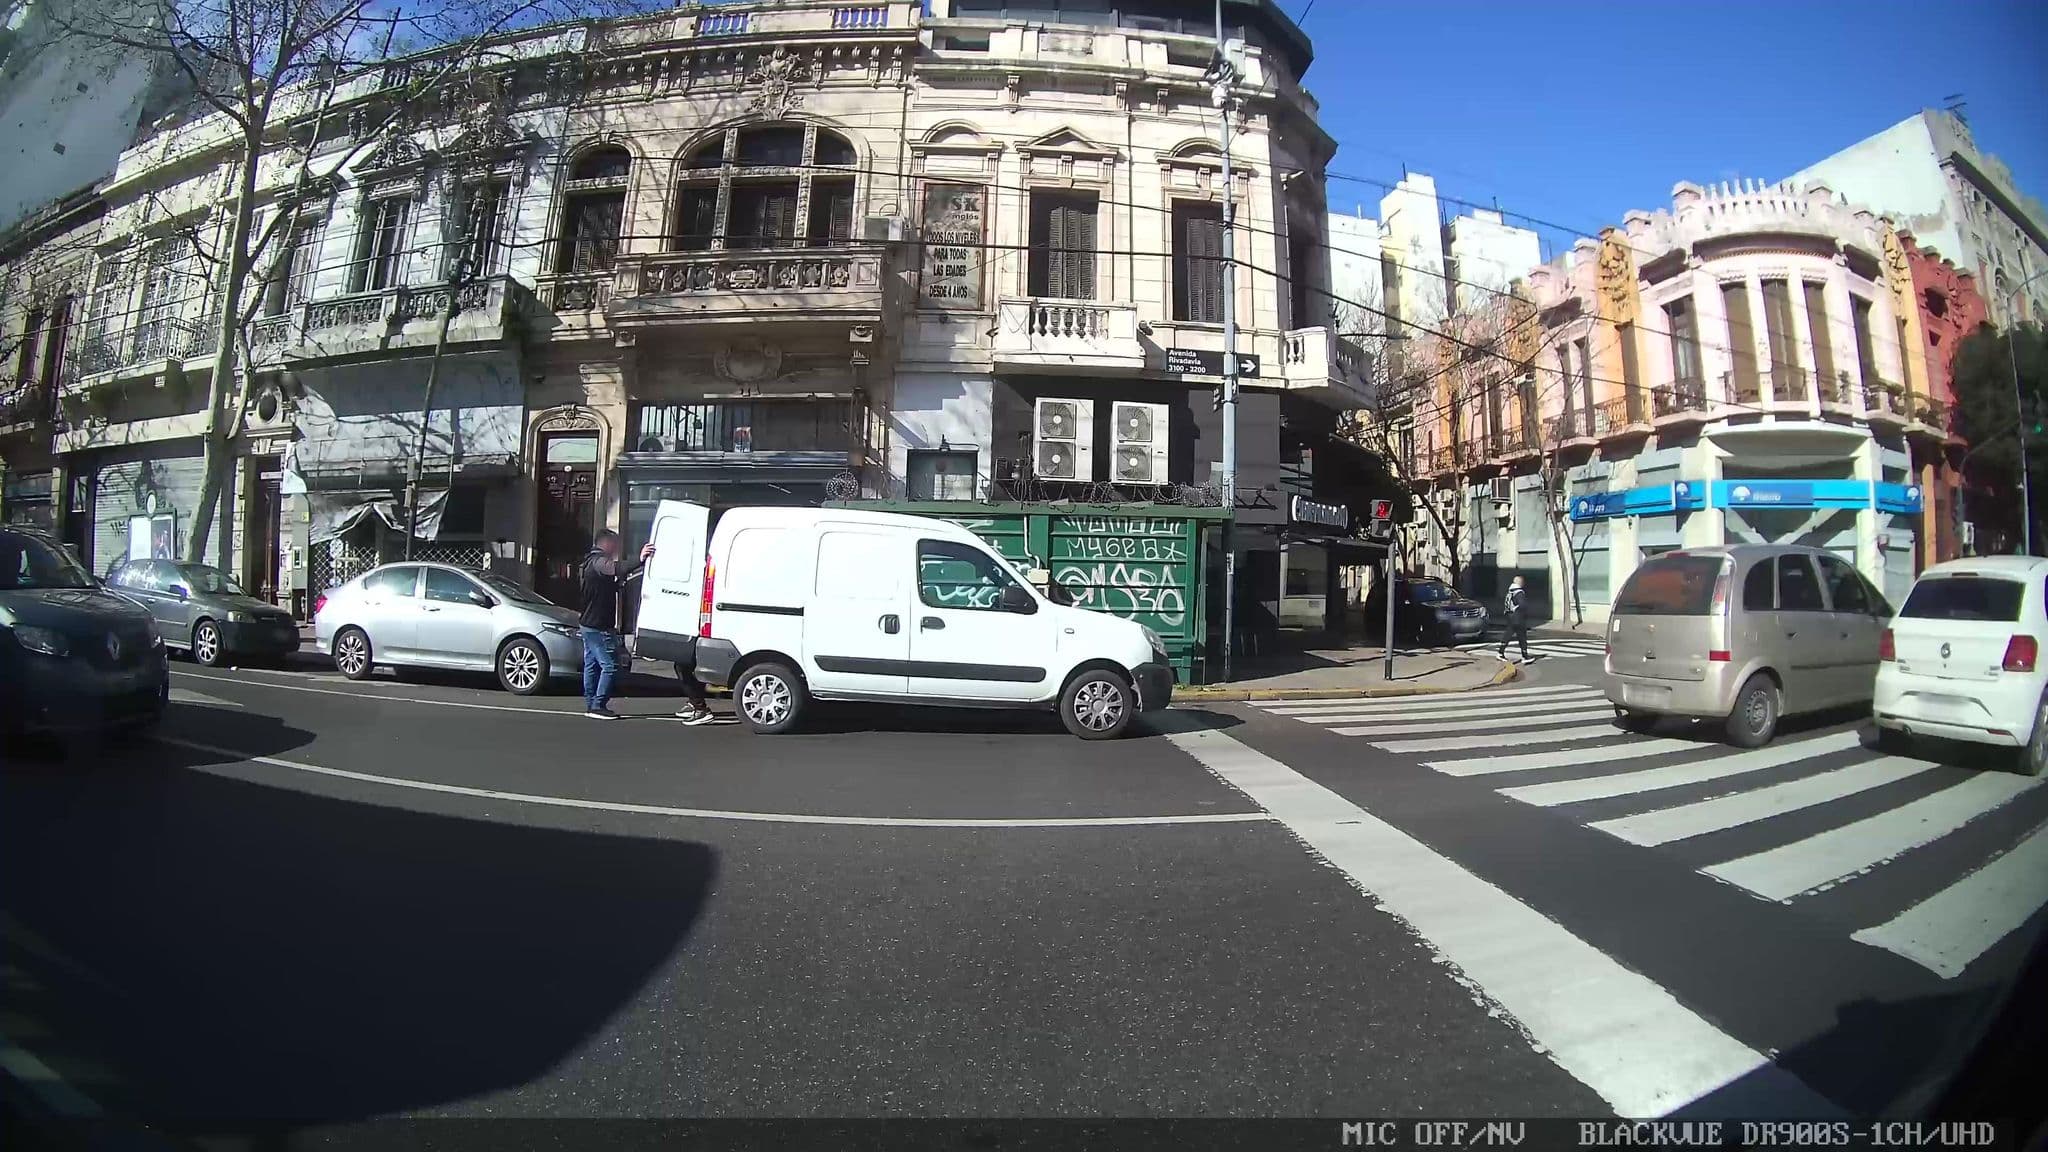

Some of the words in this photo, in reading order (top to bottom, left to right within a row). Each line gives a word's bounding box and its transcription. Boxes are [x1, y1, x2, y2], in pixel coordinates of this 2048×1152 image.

[934, 247, 948, 260] PARA
[949, 247, 967, 260] TODAS
[933, 264, 944, 276] LAS
[945, 264, 967, 277] EDADES
[929, 285, 947, 298] DESDE
[1168, 349, 1197, 357] Avenida
[1168, 356, 1202, 365] Rivadavia
[1167, 364, 1184, 373] 3100
[1189, 365, 1206, 374] 3200
